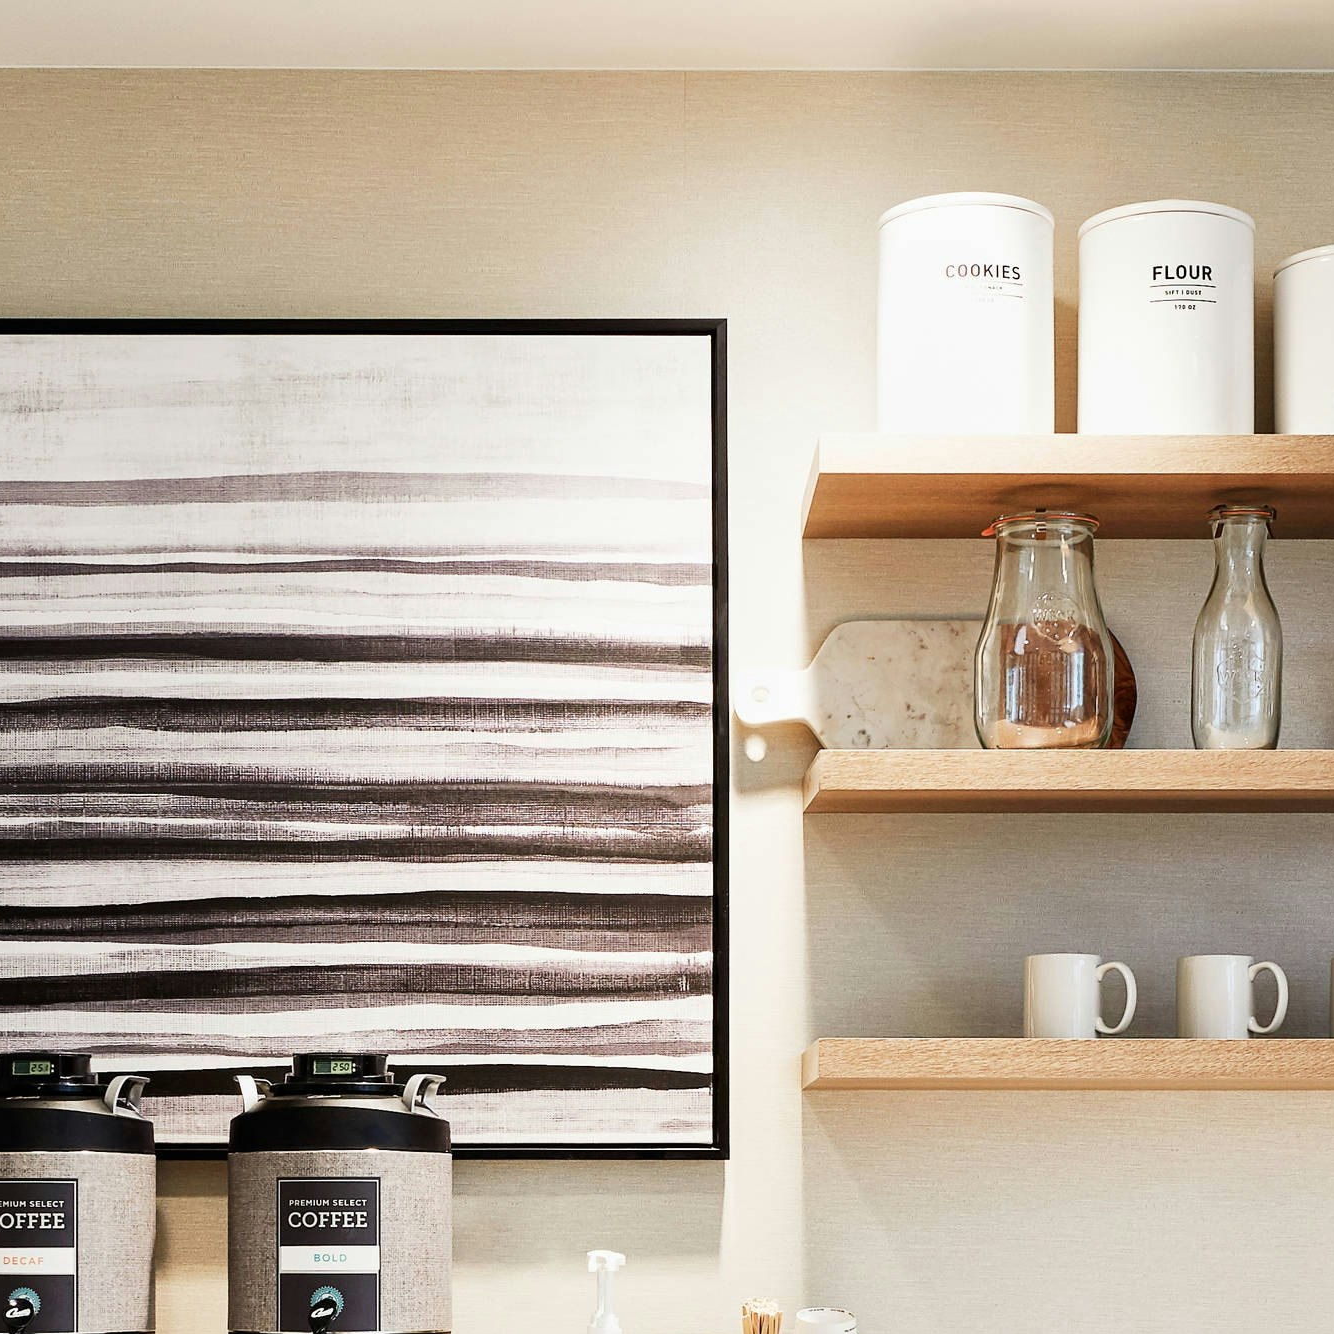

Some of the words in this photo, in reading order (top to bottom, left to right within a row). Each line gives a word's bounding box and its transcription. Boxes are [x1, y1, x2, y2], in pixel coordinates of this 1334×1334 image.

[945, 263, 1021, 280] COOKIES
[1152, 264, 1213, 281] FLOUR
[29, 1200, 65, 1208] SELECT
[289, 1199, 330, 1207] PREMIUM
[332, 1199, 368, 1207] SELECT
[288, 1211, 368, 1228] COFFEE
[3, 1256, 44, 1265] DECAF
[313, 1253, 348, 1262] BOLD
